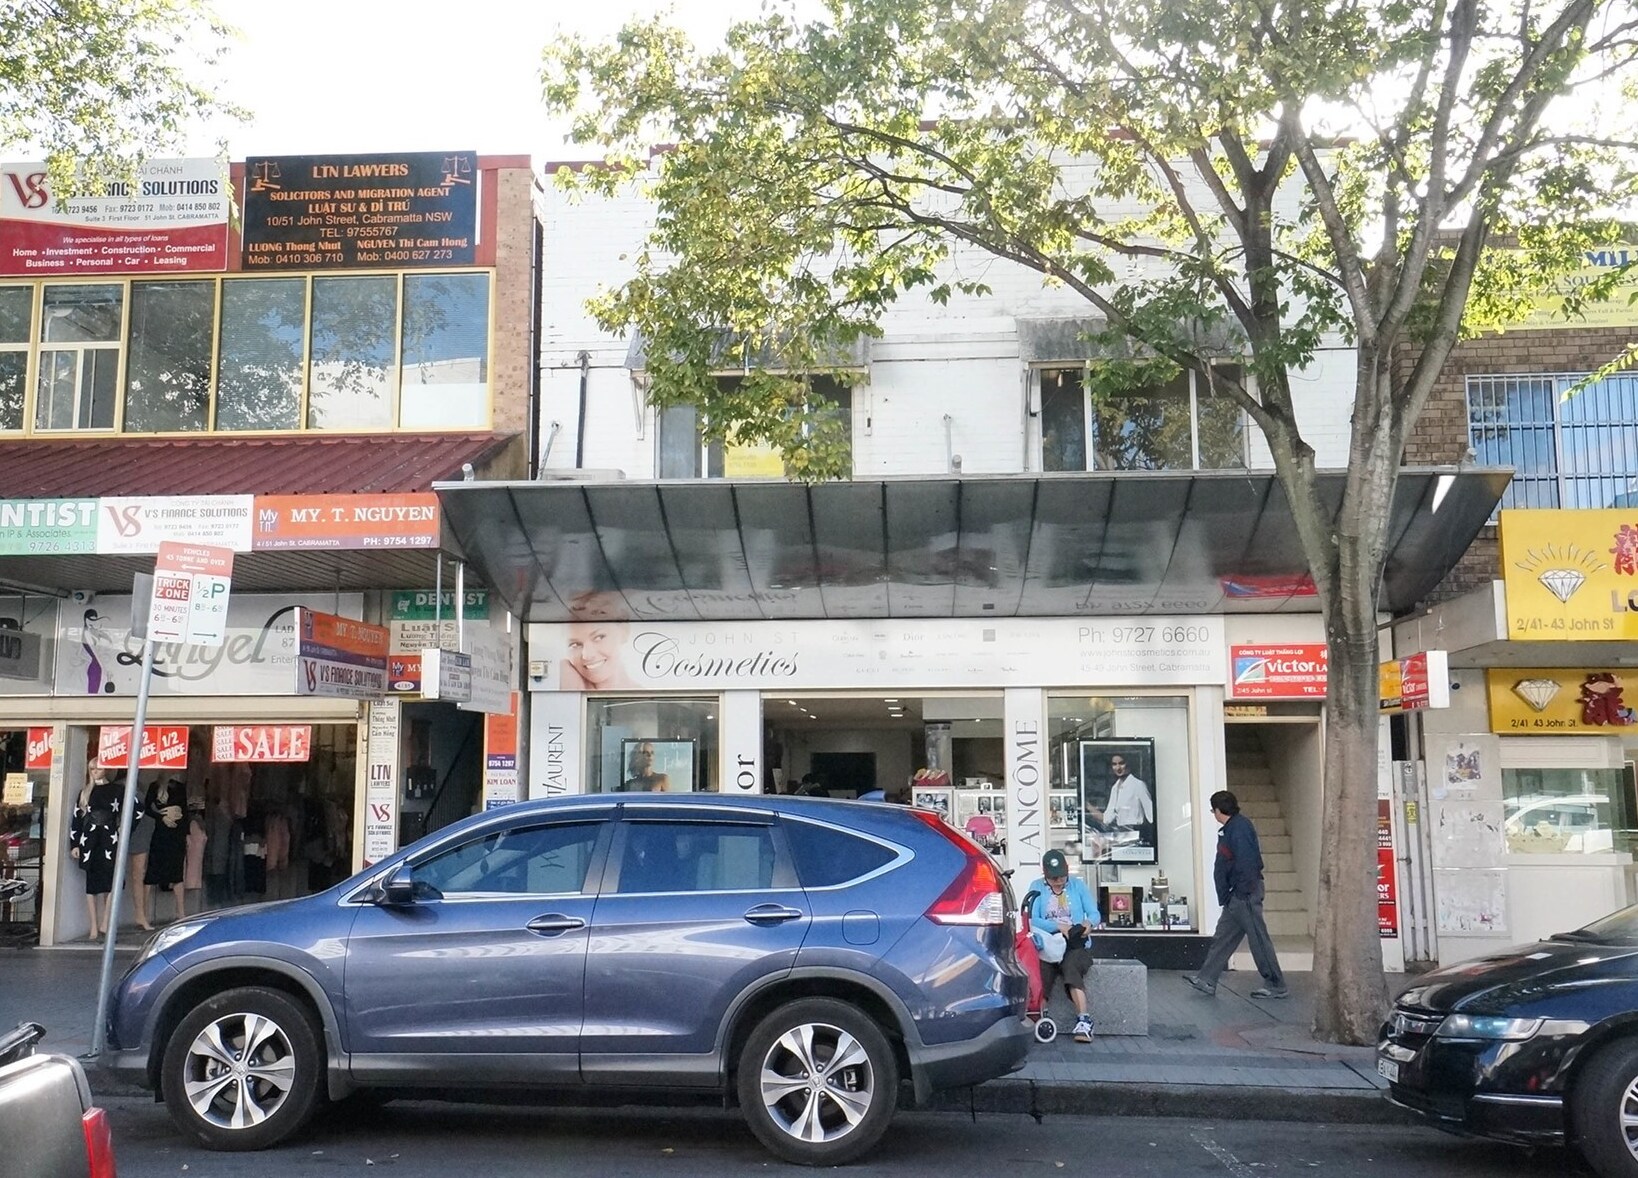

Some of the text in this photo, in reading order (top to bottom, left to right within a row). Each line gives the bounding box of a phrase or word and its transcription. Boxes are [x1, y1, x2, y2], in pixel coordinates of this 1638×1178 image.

[313, 163, 409, 179] LTN LAWYERS
[143, 179, 219, 198] SOLUTIONS
[270, 187, 452, 202] SOLICITORS AND MIGRATION AGENT
[66, 206, 80, 214] 723
[81, 206, 98, 214] 9456
[120, 204, 136, 213] 9723
[138, 203, 154, 213] 0172
[177, 203, 193, 212] 0414
[195, 202, 207, 212] 850
[208, 201, 221, 211] 802
[359, 202, 369, 213] &
[266, 212, 453, 227] 10/51 John Street, Cabramatta NSW
[124, 235, 141, 244] types
[142, 234, 150, 242] of
[150, 234, 169, 242] loans
[320, 227, 399, 238] TEL: 97555767
[13, 243, 216, 257] Home Investment Construction Commercial
[357, 239, 396, 249] NGUYEN
[417, 238, 440, 248] Cam
[441, 237, 468, 249] Hong
[26, 255, 187, 268] Business Personal Car Leasing
[249, 250, 453, 265] Mob: 0410 306 710 Mob: 0400 627 273
[2, 501, 97, 528] NTIST
[161, 508, 198, 519] FINANCE
[200, 506, 248, 518] SOLUTIONS
[290, 505, 435, 523] MY. T. NGUYEN
[104, 505, 143, 538] VS
[27, 528, 72, 539] Associates
[30, 540, 96, 552] 9726 4313
[298, 537, 340, 547] CABRAMATTA
[363, 536, 433, 550] PH: 9754 1297
[157, 577, 190, 590] TRUCK
[156, 588, 190, 600] ZONE
[415, 591, 486, 607] DENTST
[276, 625, 295, 635] LAD
[1568, 617, 1600, 632] John
[688, 631, 801, 646] JOHN ST
[1078, 625, 1210, 644] Ph: 9727 6660
[632, 631, 799, 679] Cosmetics
[1158, 662, 1210, 672] Cabramatta
[1266, 659, 1316, 673] victor
[1545, 718, 1566, 729] John
[103, 730, 121, 747] 1/2
[161, 731, 179, 747] 1/2
[238, 727, 306, 760] SALE
[100, 742, 128, 763] PRICE
[140, 742, 157, 759] ICE
[159, 742, 187, 763] PRICE
[370, 764, 392, 781] LTN
[736, 754, 756, 791] or
[1012, 720, 1041, 867] LANCÔME
[371, 803, 391, 824] VS
